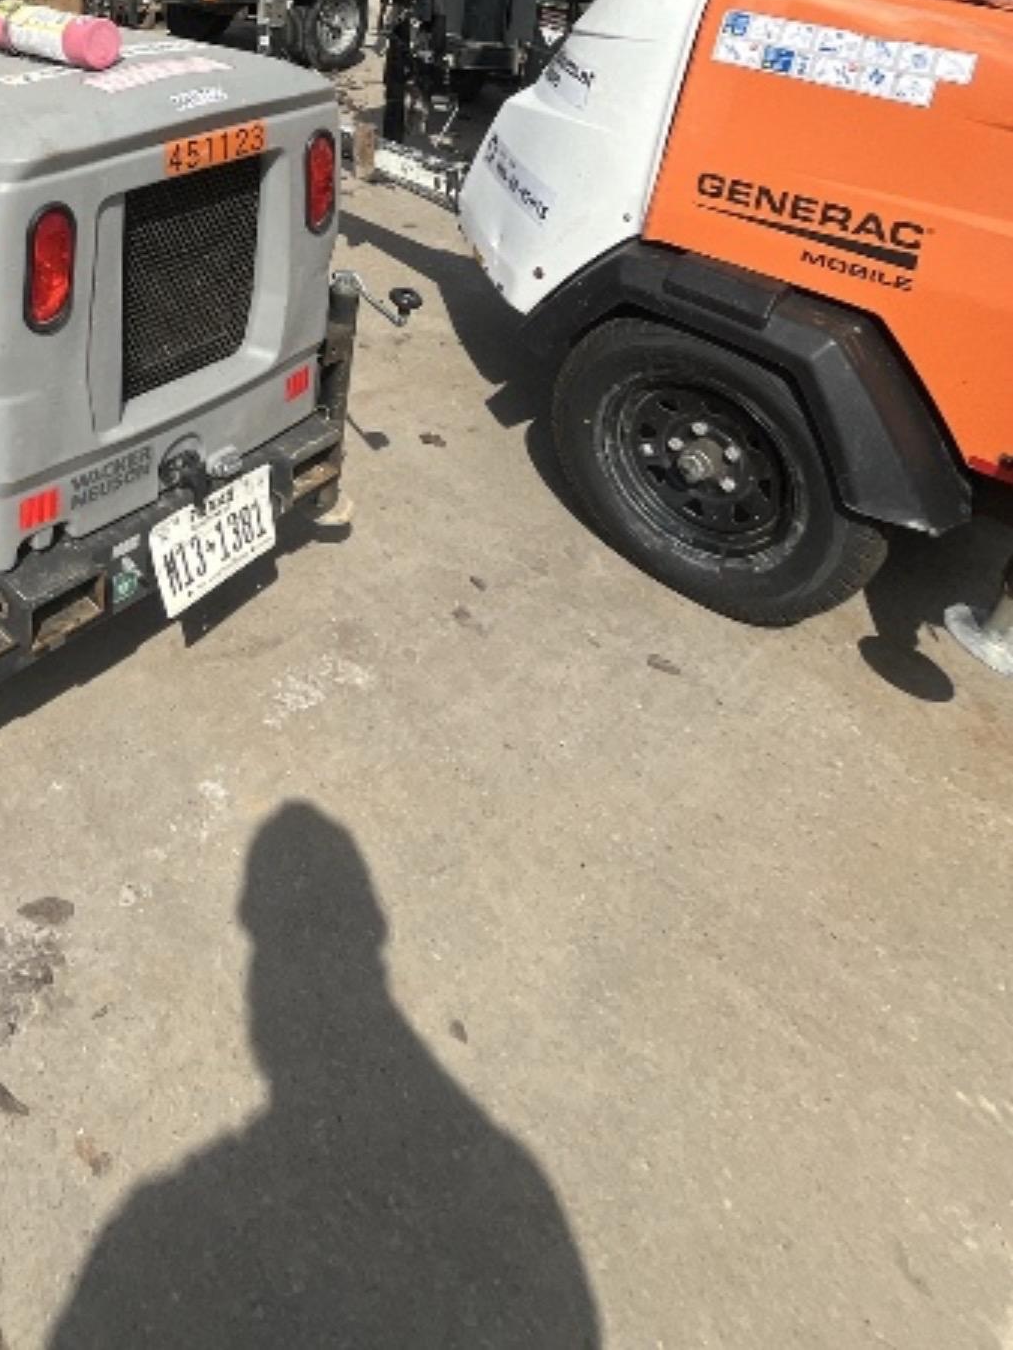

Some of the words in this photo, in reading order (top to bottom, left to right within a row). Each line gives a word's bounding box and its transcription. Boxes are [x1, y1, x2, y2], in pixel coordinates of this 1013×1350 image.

[169, 124, 265, 171] 451123
[696, 172, 925, 250] GENERAC
[800, 249, 914, 292] MOBILE
